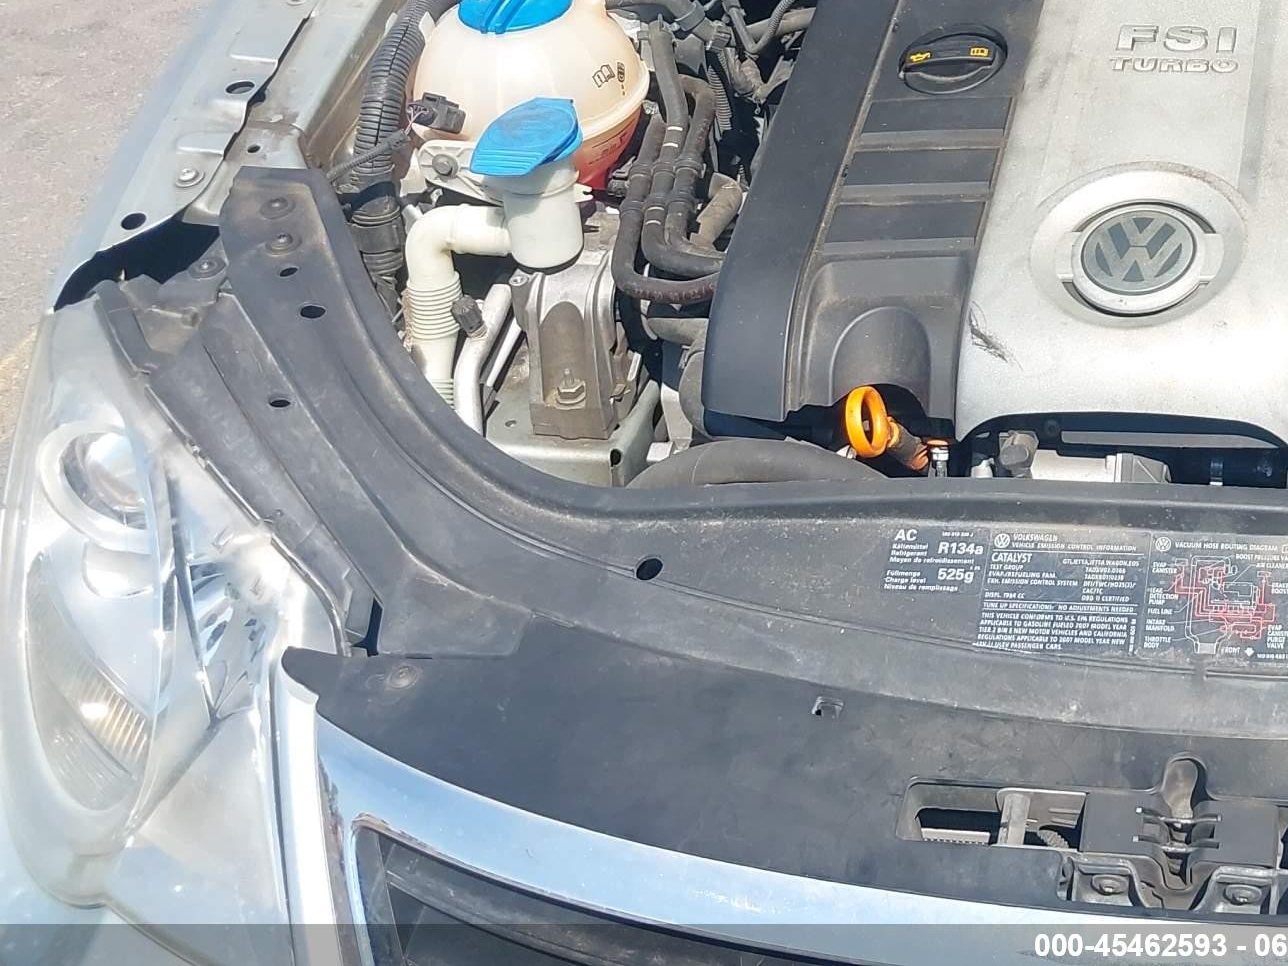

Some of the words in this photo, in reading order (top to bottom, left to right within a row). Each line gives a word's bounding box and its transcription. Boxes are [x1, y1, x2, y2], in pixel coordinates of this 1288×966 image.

[1115, 24, 1237, 53] FSI
[1109, 56, 1239, 74] TURBO
[894, 529, 918, 541] AC
[1013, 534, 1058, 542] VOLKSWAGEN
[938, 542, 984, 554] R134a
[992, 552, 1032, 563] CATALYST
[938, 568, 974, 584] 525g
